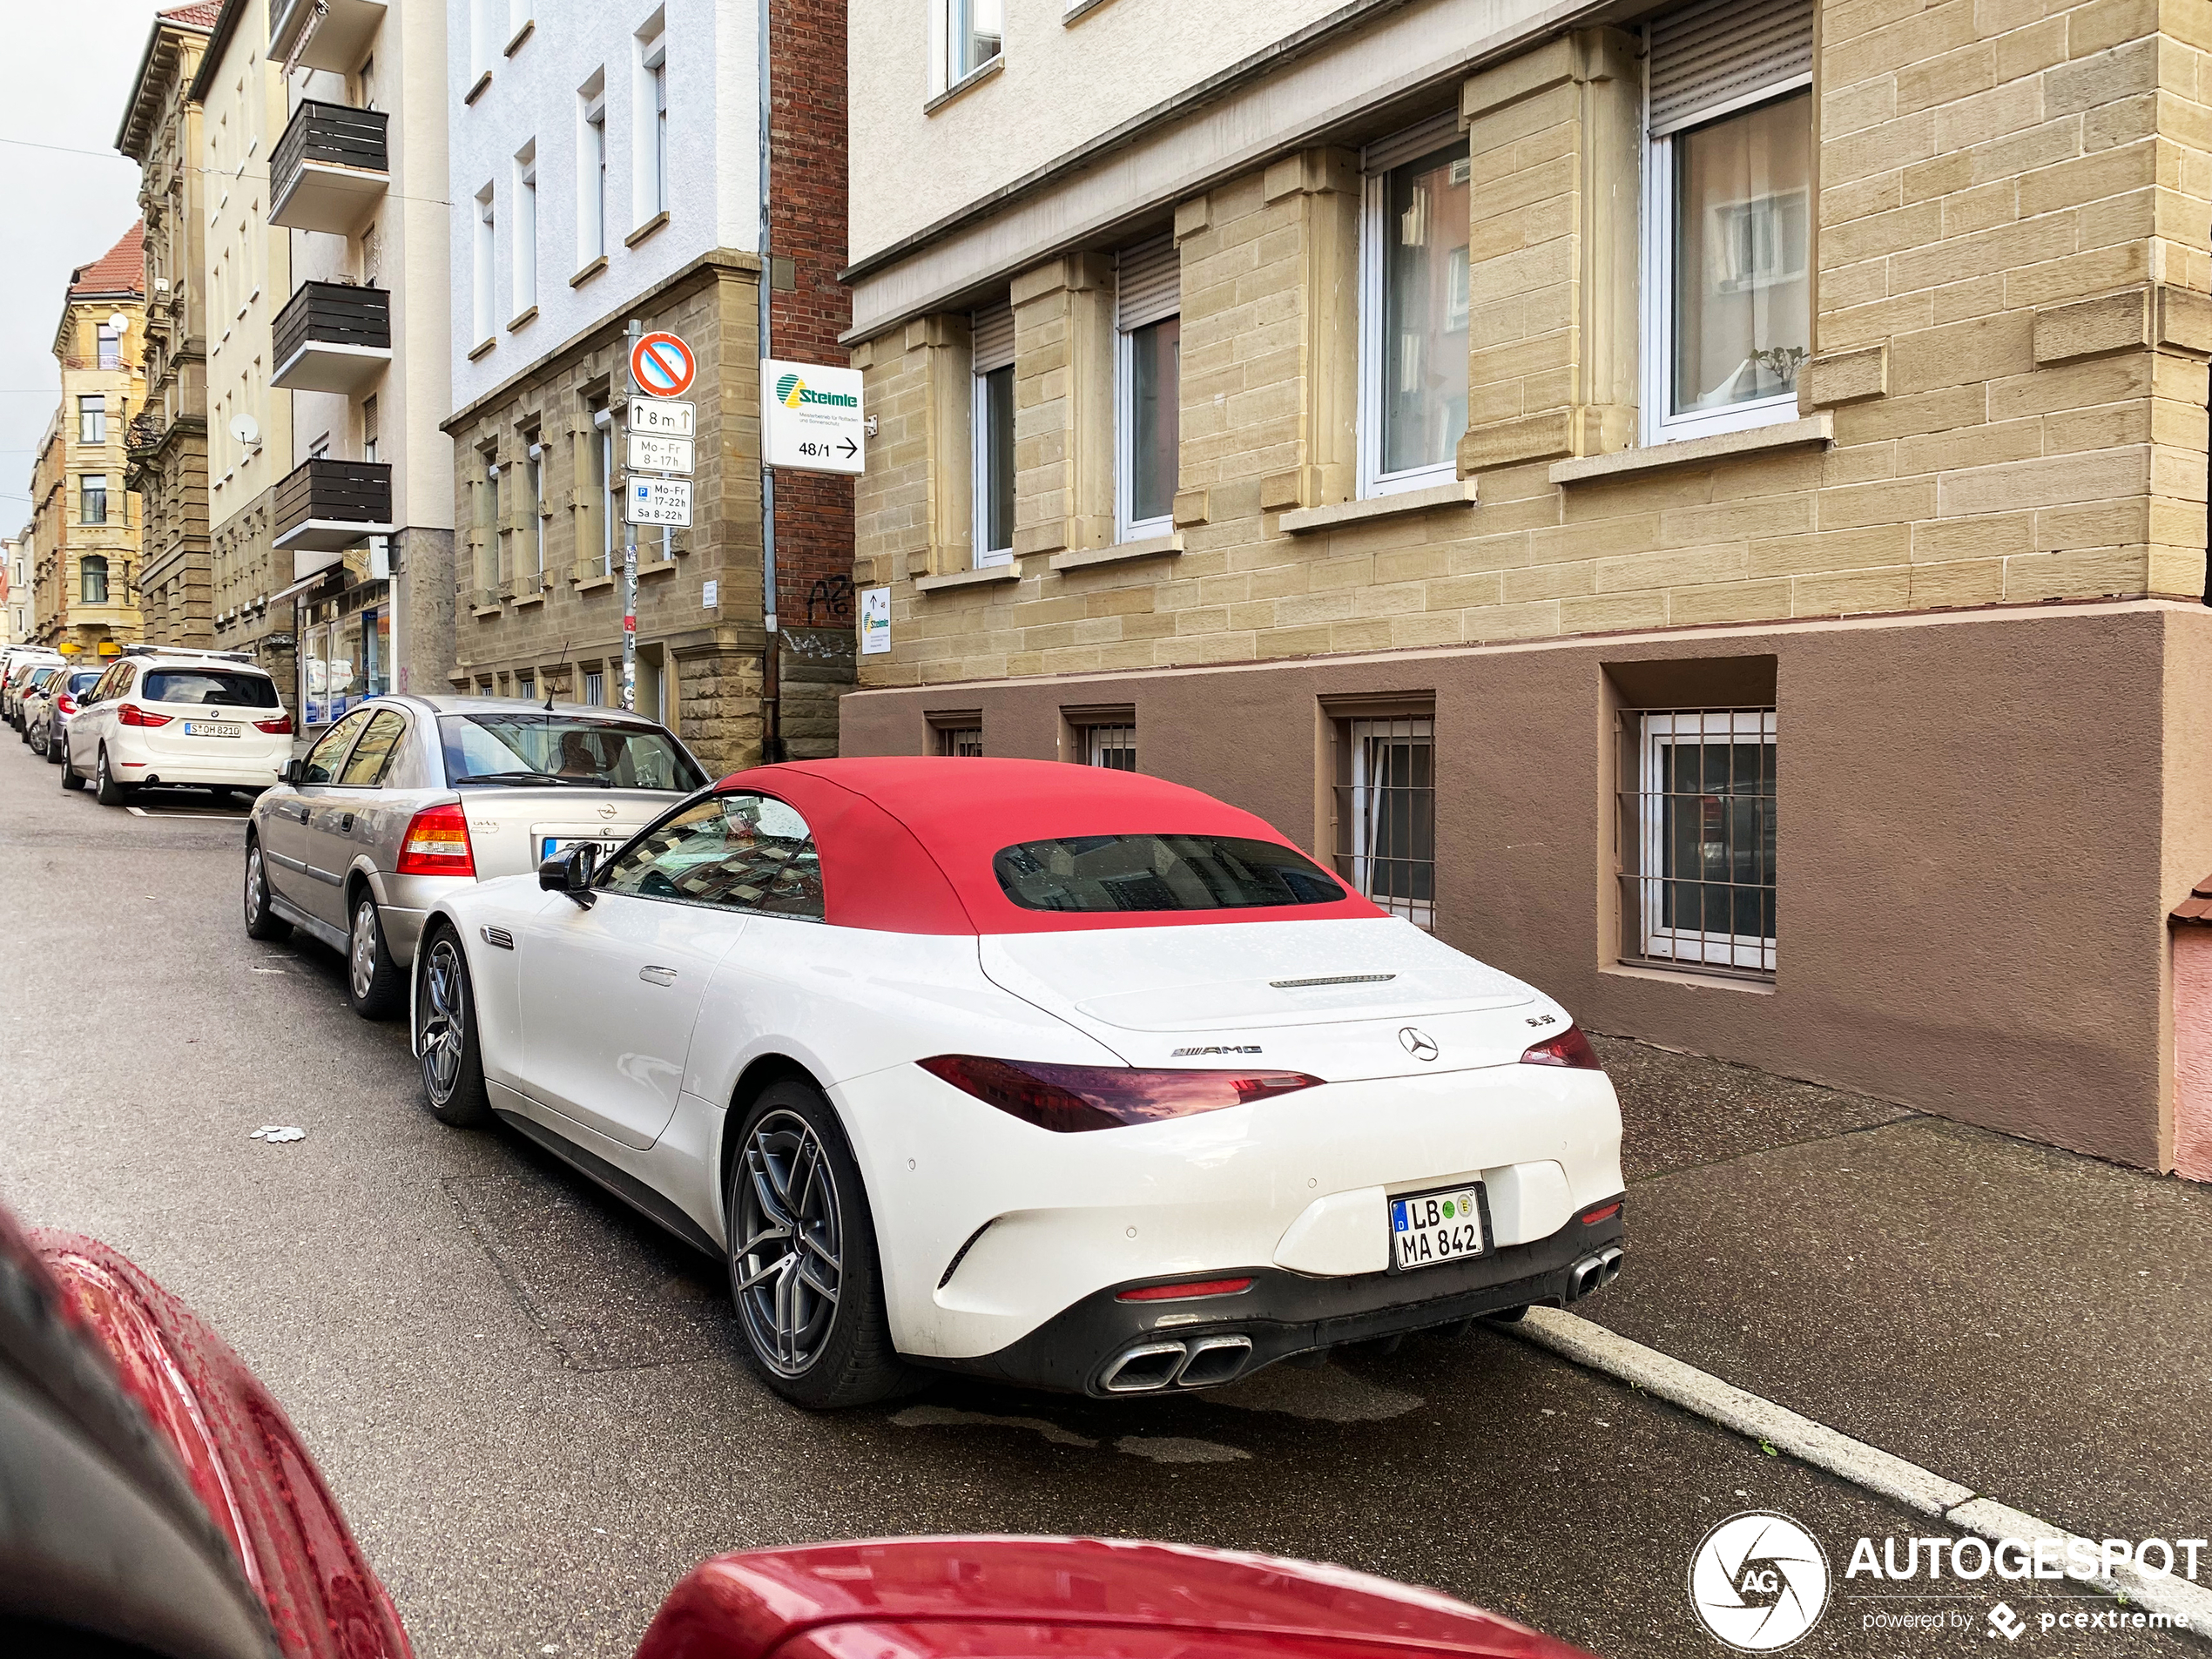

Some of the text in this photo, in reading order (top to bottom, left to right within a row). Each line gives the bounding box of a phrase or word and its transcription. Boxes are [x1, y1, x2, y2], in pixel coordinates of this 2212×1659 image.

[799, 388, 858, 408] Steimle
[649, 412, 676, 428] 8 m
[799, 442, 829, 457] 48/1
[637, 509, 650, 518] Sa
[1200, 1046, 1263, 1055] AMG
[1412, 1200, 1440, 1230] LB
[1399, 1220, 1405, 1231] D
[1402, 1224, 1477, 1263] MA 842
